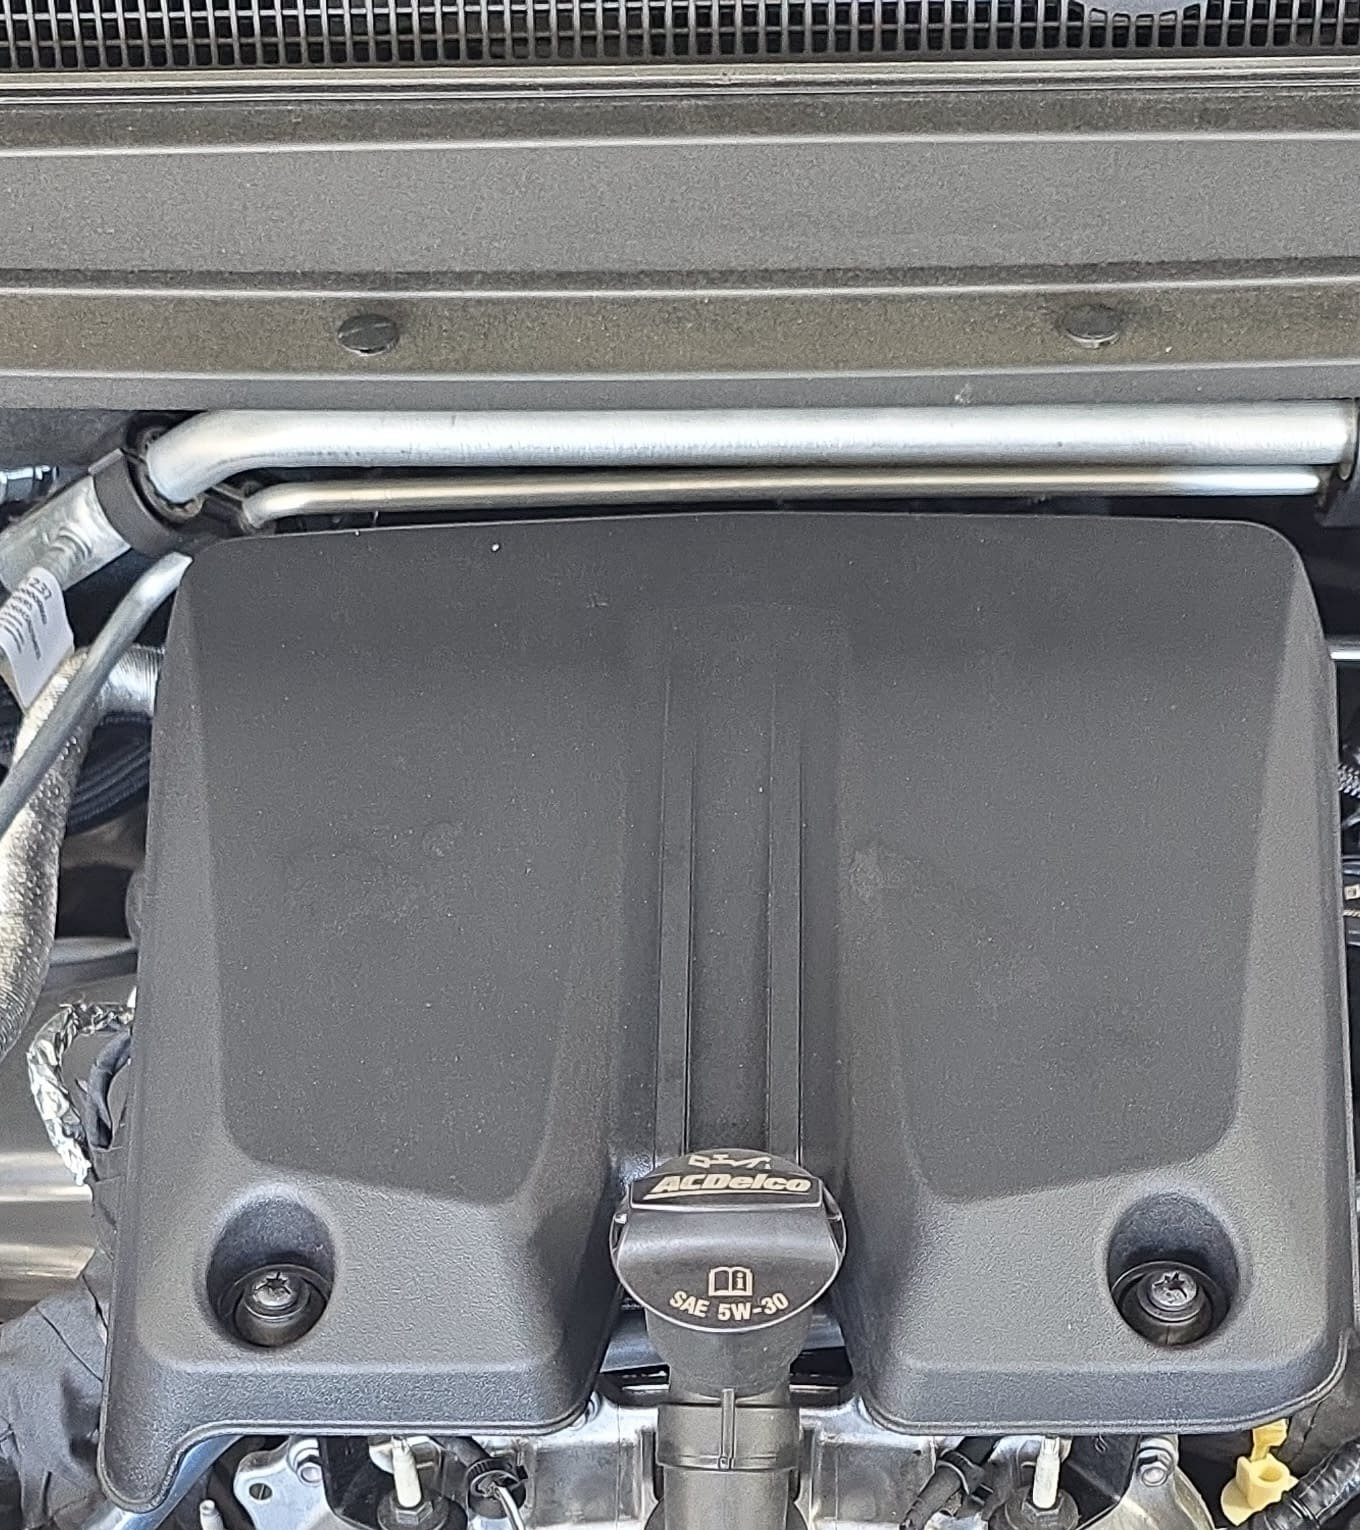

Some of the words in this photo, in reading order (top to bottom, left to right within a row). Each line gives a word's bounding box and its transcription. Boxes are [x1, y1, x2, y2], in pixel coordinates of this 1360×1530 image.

[645, 1174, 812, 1200] ACDelco
[670, 1291, 710, 1318] SAE
[717, 1293, 789, 1321] 5W-30
